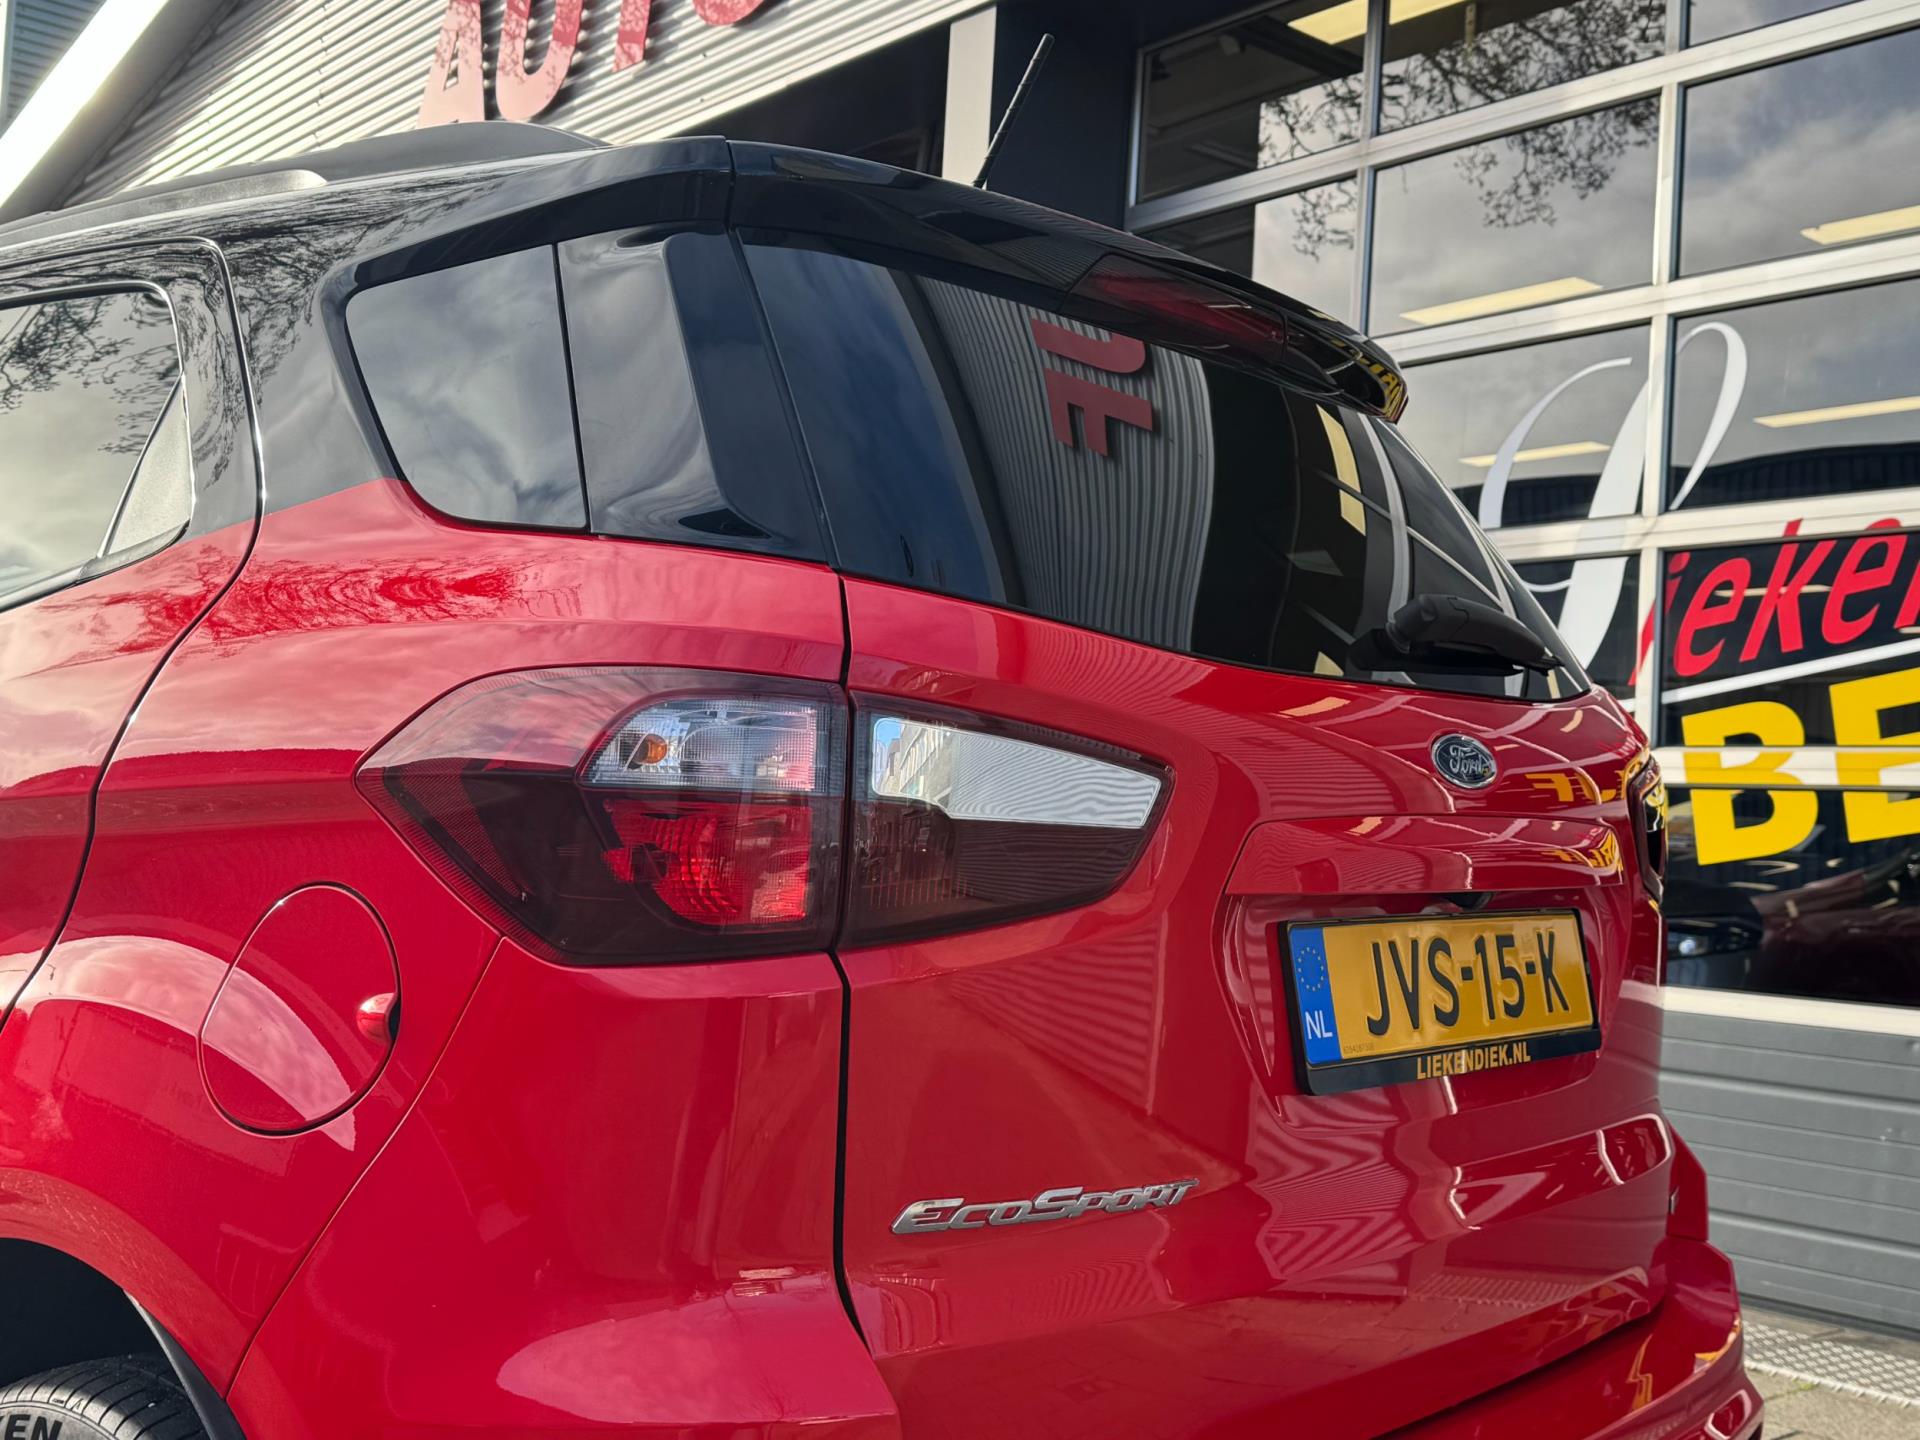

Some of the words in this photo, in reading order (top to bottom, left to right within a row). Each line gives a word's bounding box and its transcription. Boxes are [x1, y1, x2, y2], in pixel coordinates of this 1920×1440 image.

[1366, 928, 1570, 1036] JVS-15-K
[1304, 1010, 1333, 1040] NL
[1416, 1041, 1532, 1080] LIEKENDIEK.NL
[0, 1413, 63, 1440] EN
